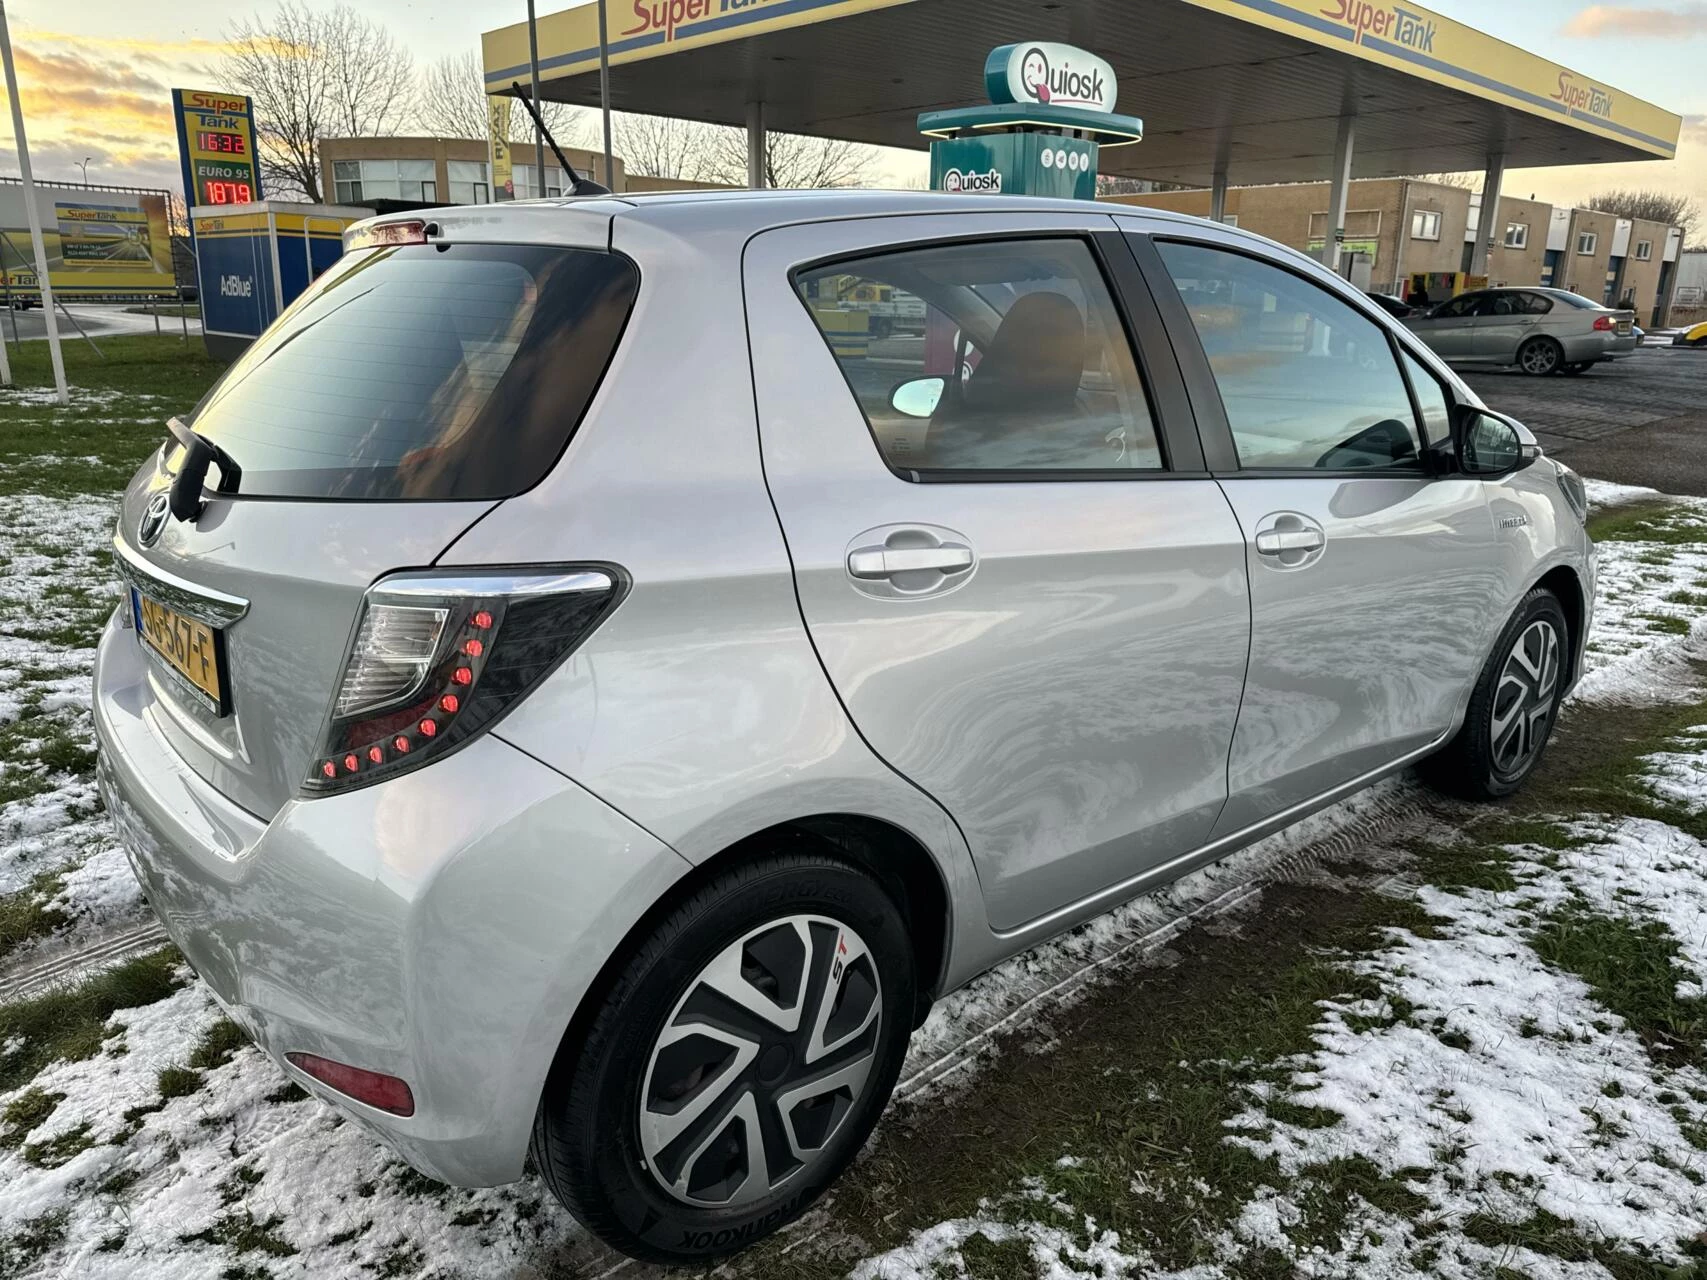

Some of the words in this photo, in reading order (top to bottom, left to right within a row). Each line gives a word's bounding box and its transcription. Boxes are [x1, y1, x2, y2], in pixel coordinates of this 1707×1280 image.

[1021, 47, 1104, 104] Quiosk
[184, 93, 246, 115] Super
[1549, 71, 1613, 118] SuperTank
[196, 114, 239, 129] Tank
[198, 166, 233, 178] EURO
[236, 169, 250, 179] 95
[945, 170, 1000, 191] Quiosk
